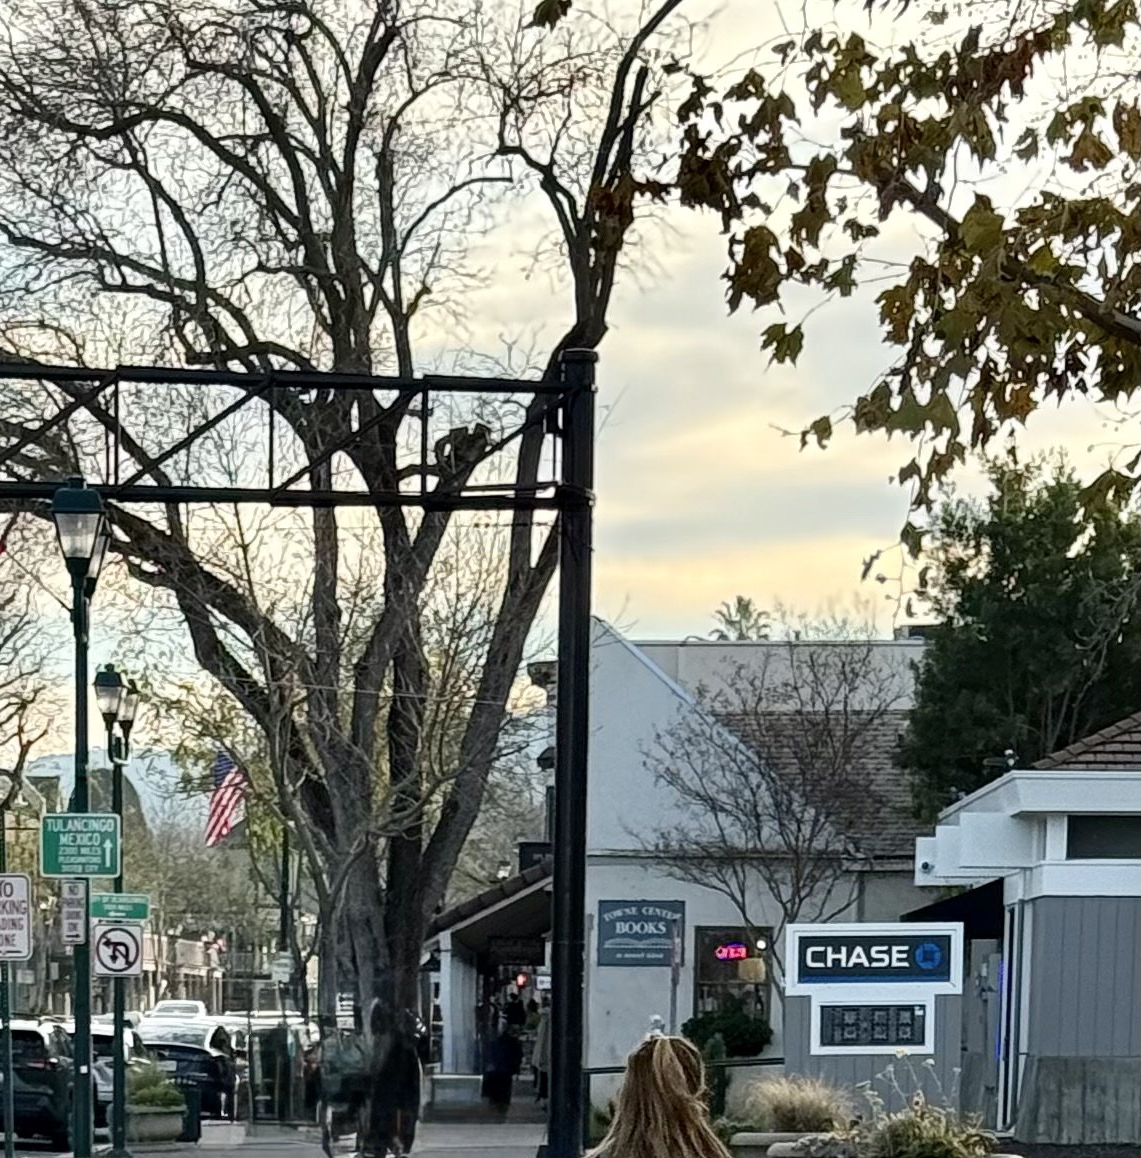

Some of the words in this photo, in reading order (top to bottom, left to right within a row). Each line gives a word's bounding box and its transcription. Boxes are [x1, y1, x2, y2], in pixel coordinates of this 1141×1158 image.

[46, 818, 115, 832] TULANCINGO
[59, 833, 101, 846] MEXICO
[603, 906, 638, 922] TOWNE
[641, 906, 682, 920] CENTER
[615, 920, 667, 934] BOOKS
[805, 945, 910, 968] CHASE
